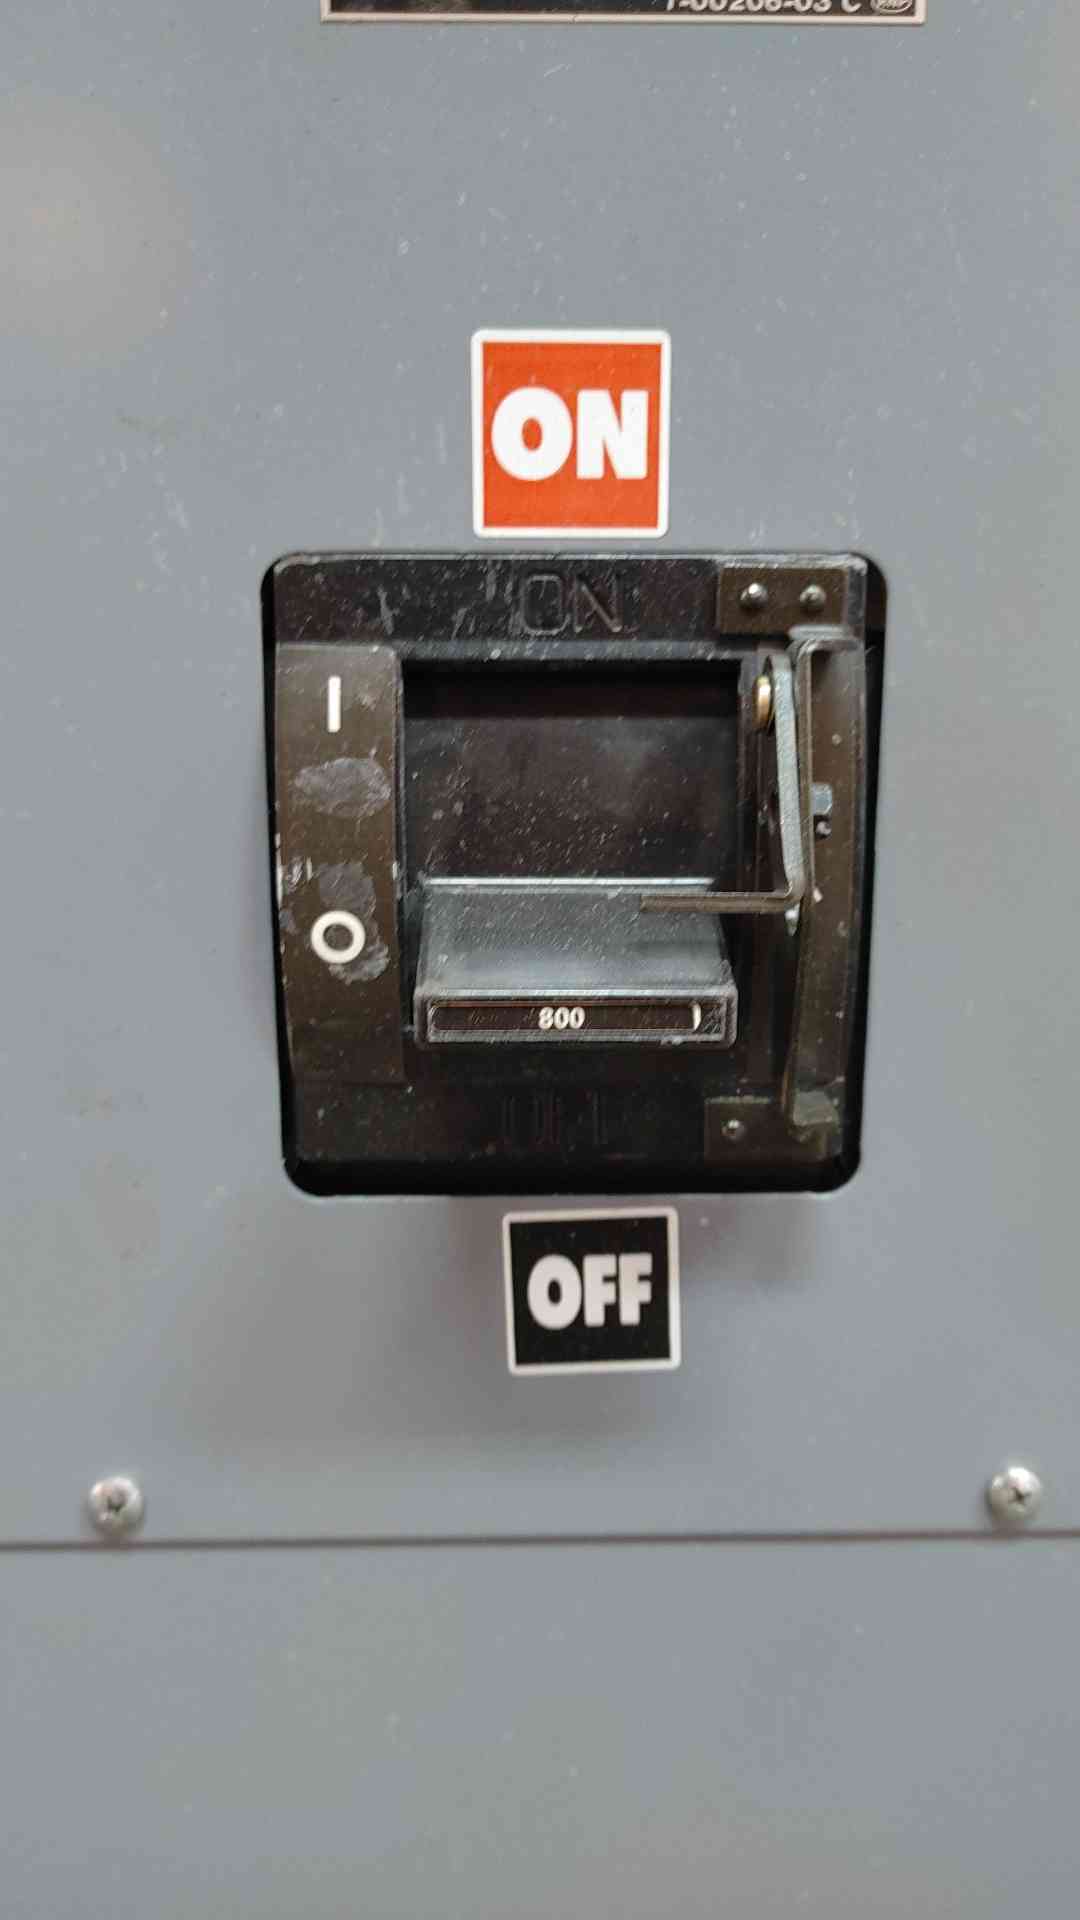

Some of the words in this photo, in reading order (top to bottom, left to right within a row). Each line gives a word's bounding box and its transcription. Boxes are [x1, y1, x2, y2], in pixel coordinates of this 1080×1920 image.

[491, 386, 649, 481] ON
[520, 574, 622, 635] ON
[537, 1005, 585, 1030] 800
[527, 1252, 653, 1330] OFF
